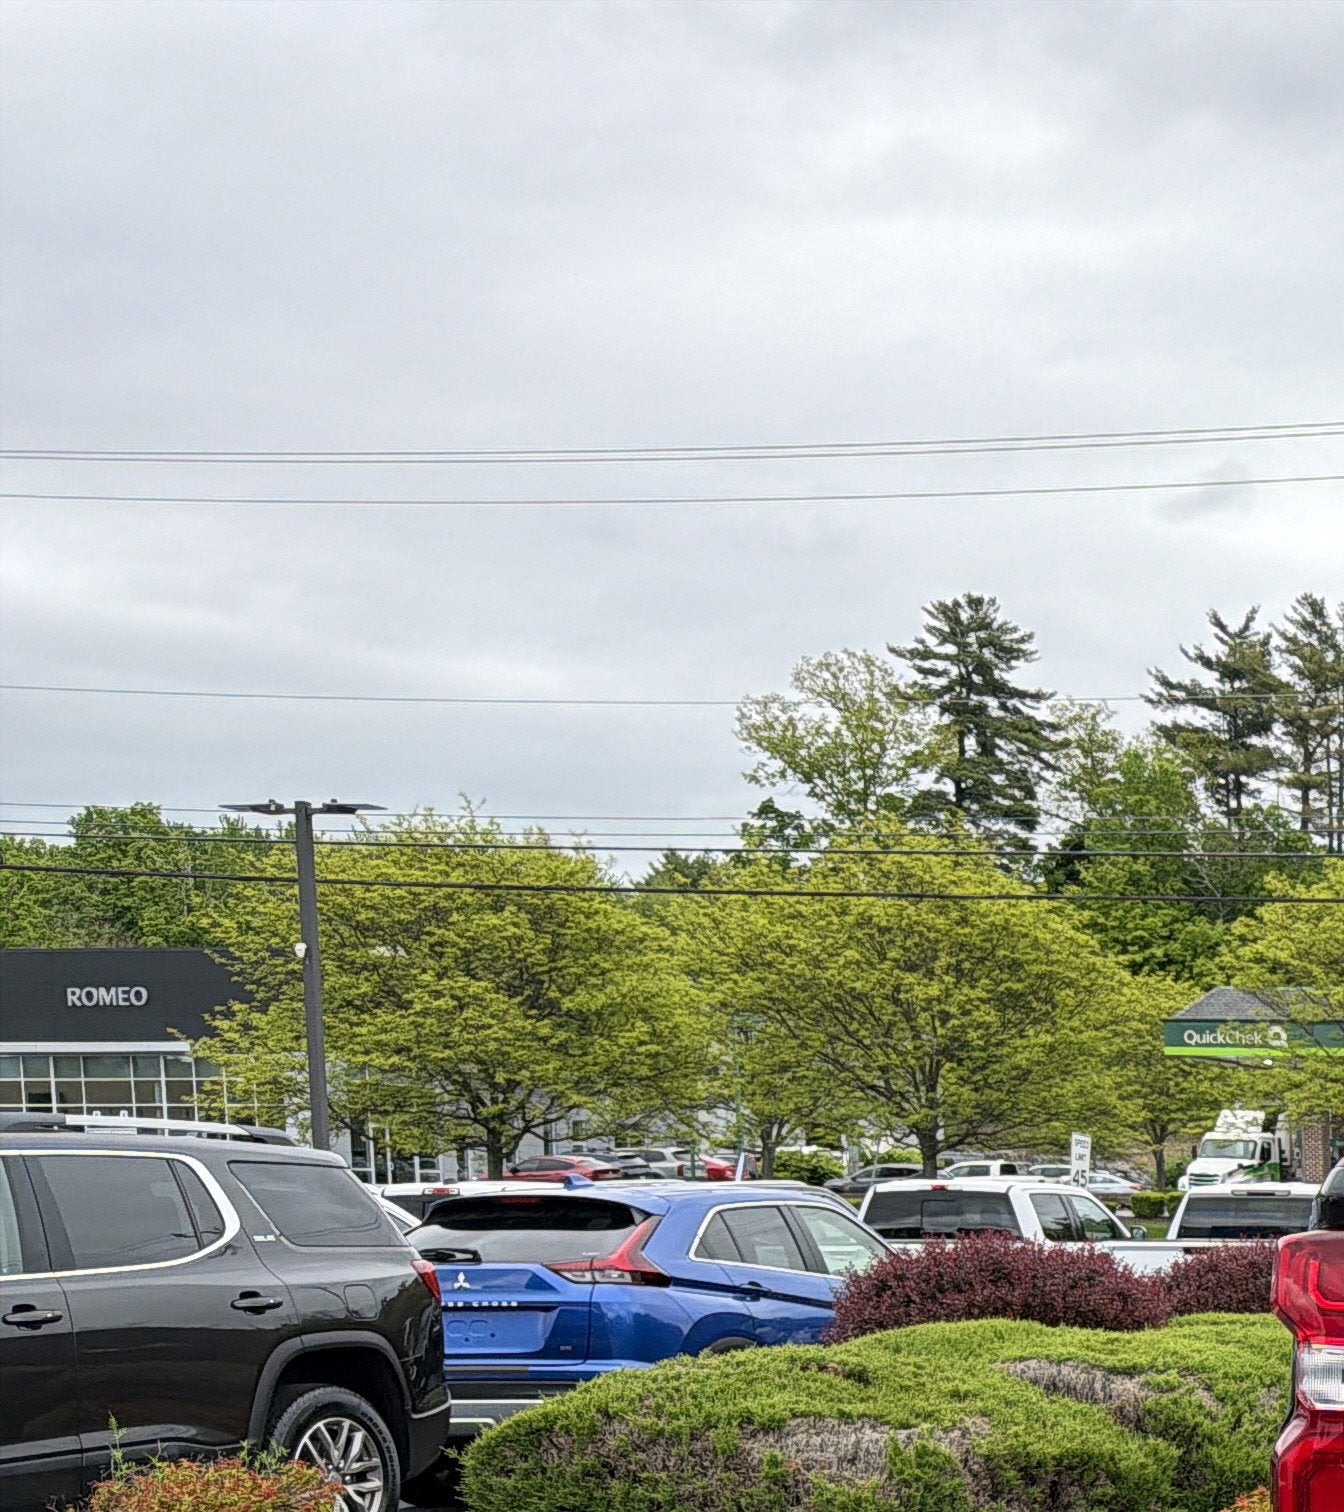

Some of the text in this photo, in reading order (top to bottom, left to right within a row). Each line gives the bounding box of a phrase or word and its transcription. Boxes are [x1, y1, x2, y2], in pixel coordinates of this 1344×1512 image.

[66, 986, 148, 1007] ROMEO
[1183, 1028, 1263, 1046] QuickChek
[1072, 1169, 1087, 1188] 45
